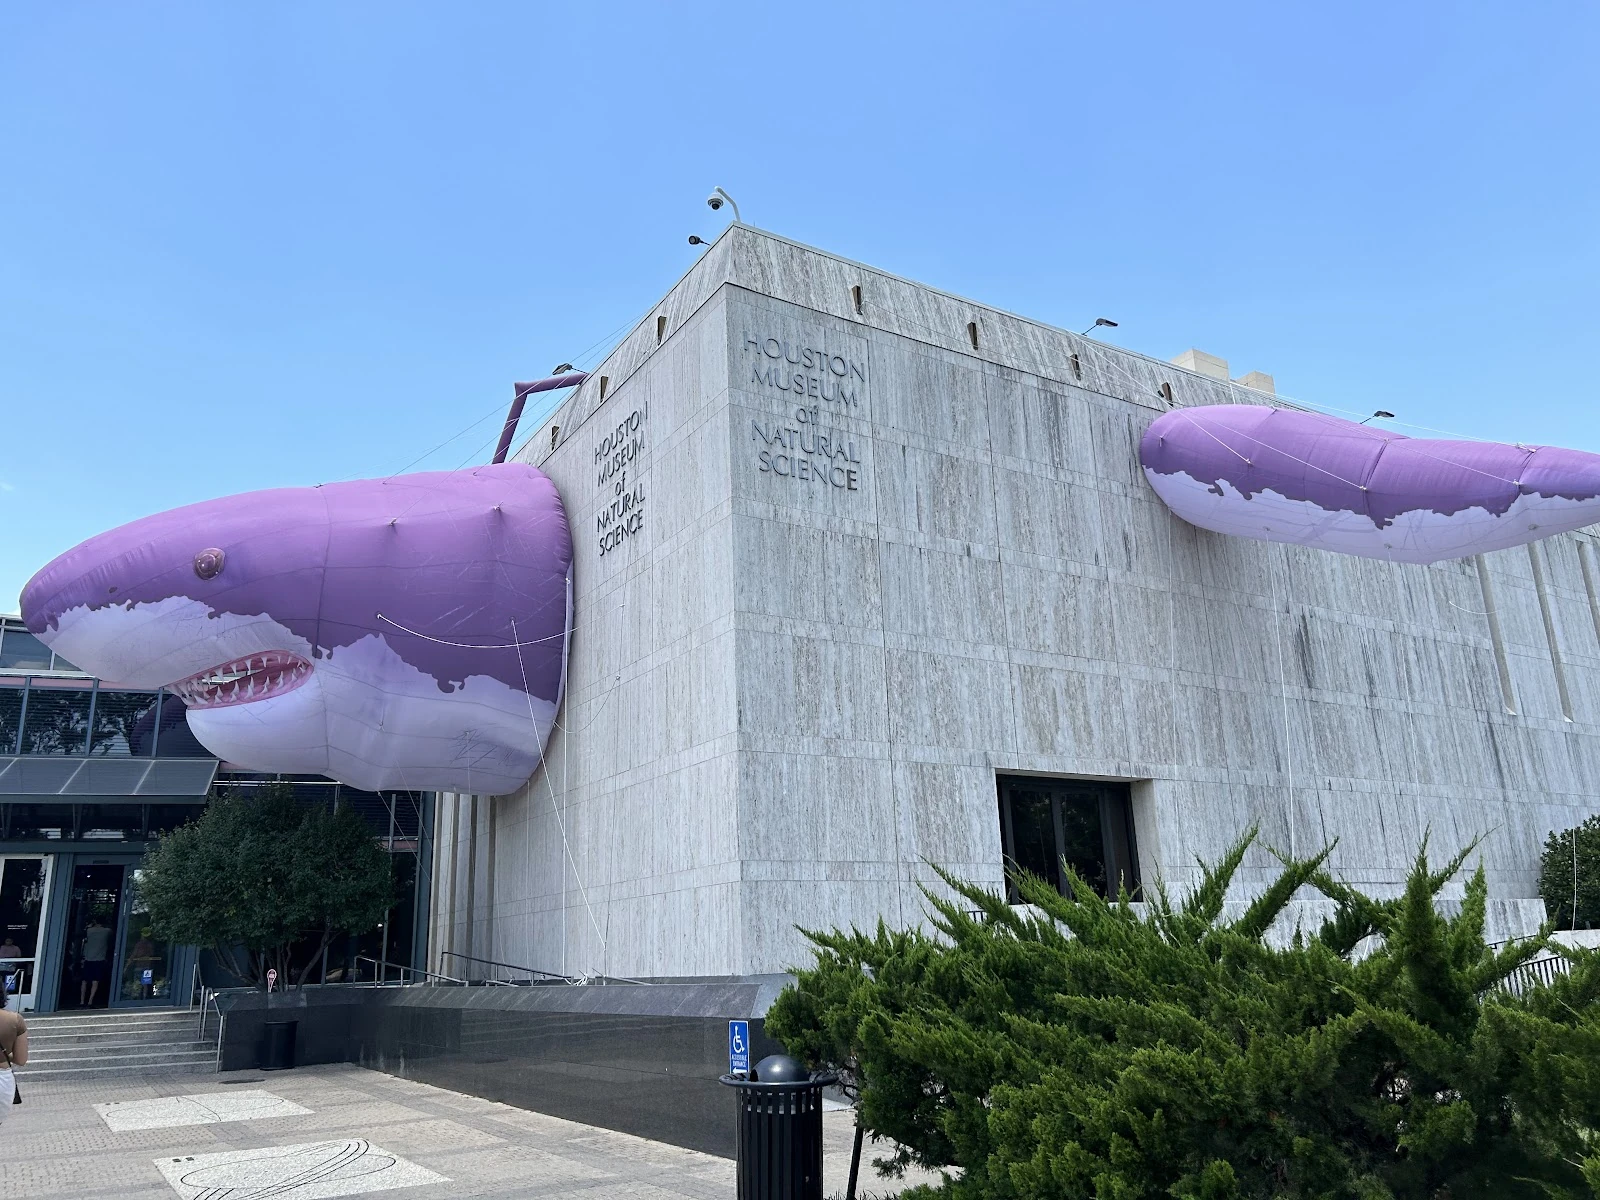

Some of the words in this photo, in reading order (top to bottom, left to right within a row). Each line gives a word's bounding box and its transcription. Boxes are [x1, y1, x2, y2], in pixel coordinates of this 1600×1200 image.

[743, 331, 865, 382] HOUSTON
[751, 362, 858, 407] MUSEUM
[594, 400, 648, 465] HOUSTON
[796, 405, 819, 425] of
[597, 430, 645, 487] MUSEUM
[751, 419, 860, 464] NATURAL
[615, 471, 626, 496] of
[758, 450, 857, 491] SCIENCE
[597, 483, 645, 533] NATURAL
[599, 508, 643, 557] SCIENCE
